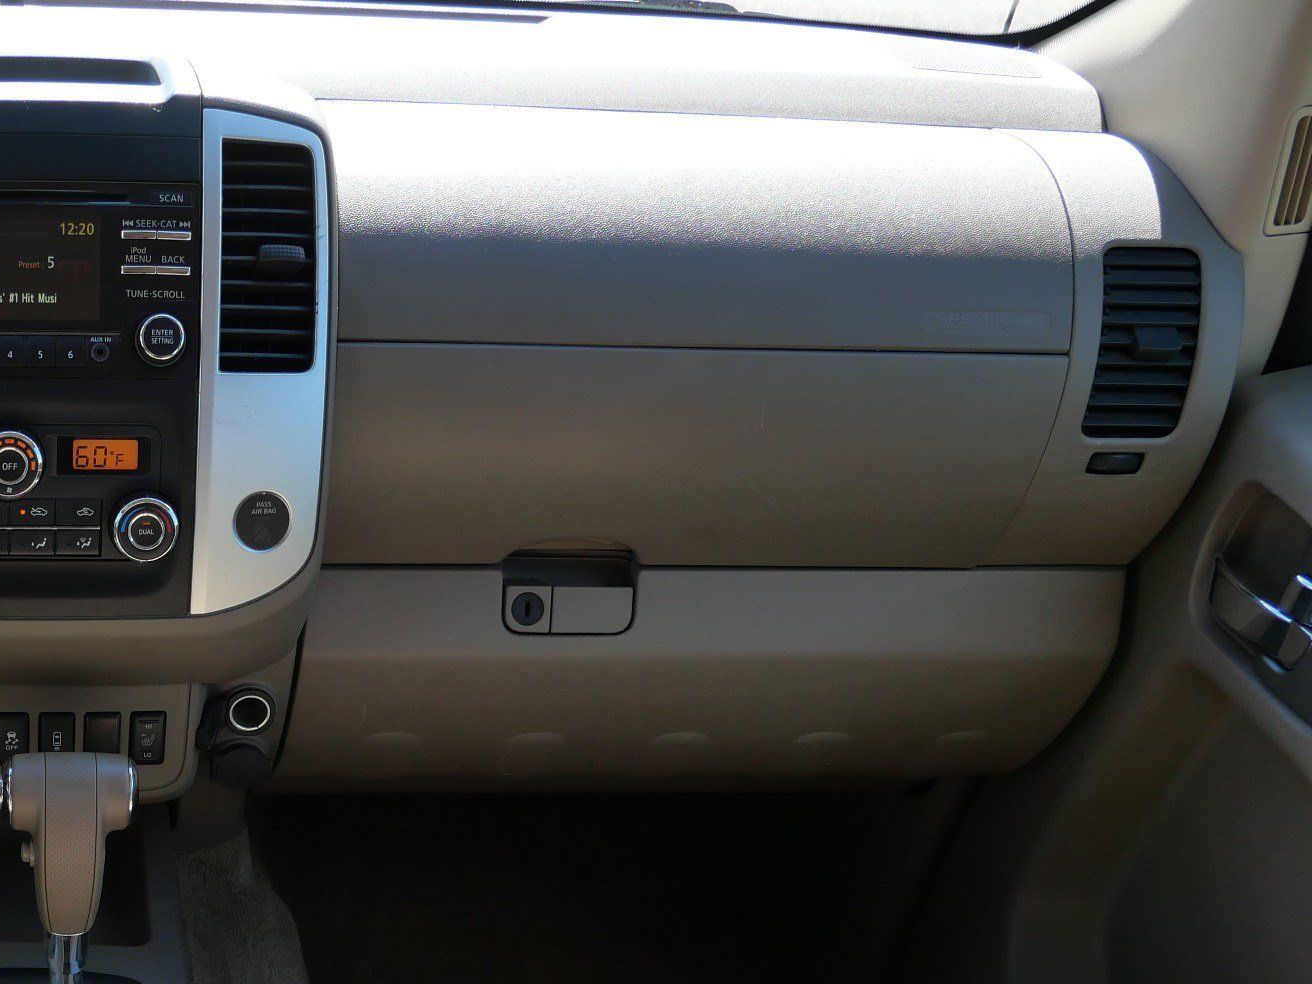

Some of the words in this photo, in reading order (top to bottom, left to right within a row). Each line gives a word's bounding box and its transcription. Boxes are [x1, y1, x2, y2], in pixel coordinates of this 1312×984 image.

[159, 194, 184, 203] SCAN
[59, 223, 95, 236] 12:20
[18, 261, 40, 269] Preset
[47, 256, 55, 269] 5
[125, 255, 152, 263] MENU
[161, 256, 185, 264] BACK
[9, 293, 18, 303] #1
[22, 293, 35, 303] Hit
[38, 293, 58, 303] Musi
[151, 337, 174, 345] SETTING
[7, 351, 13, 359] 4
[38, 351, 43, 359] 5
[67, 351, 74, 359] 6
[2, 462, 18, 471] OFF
